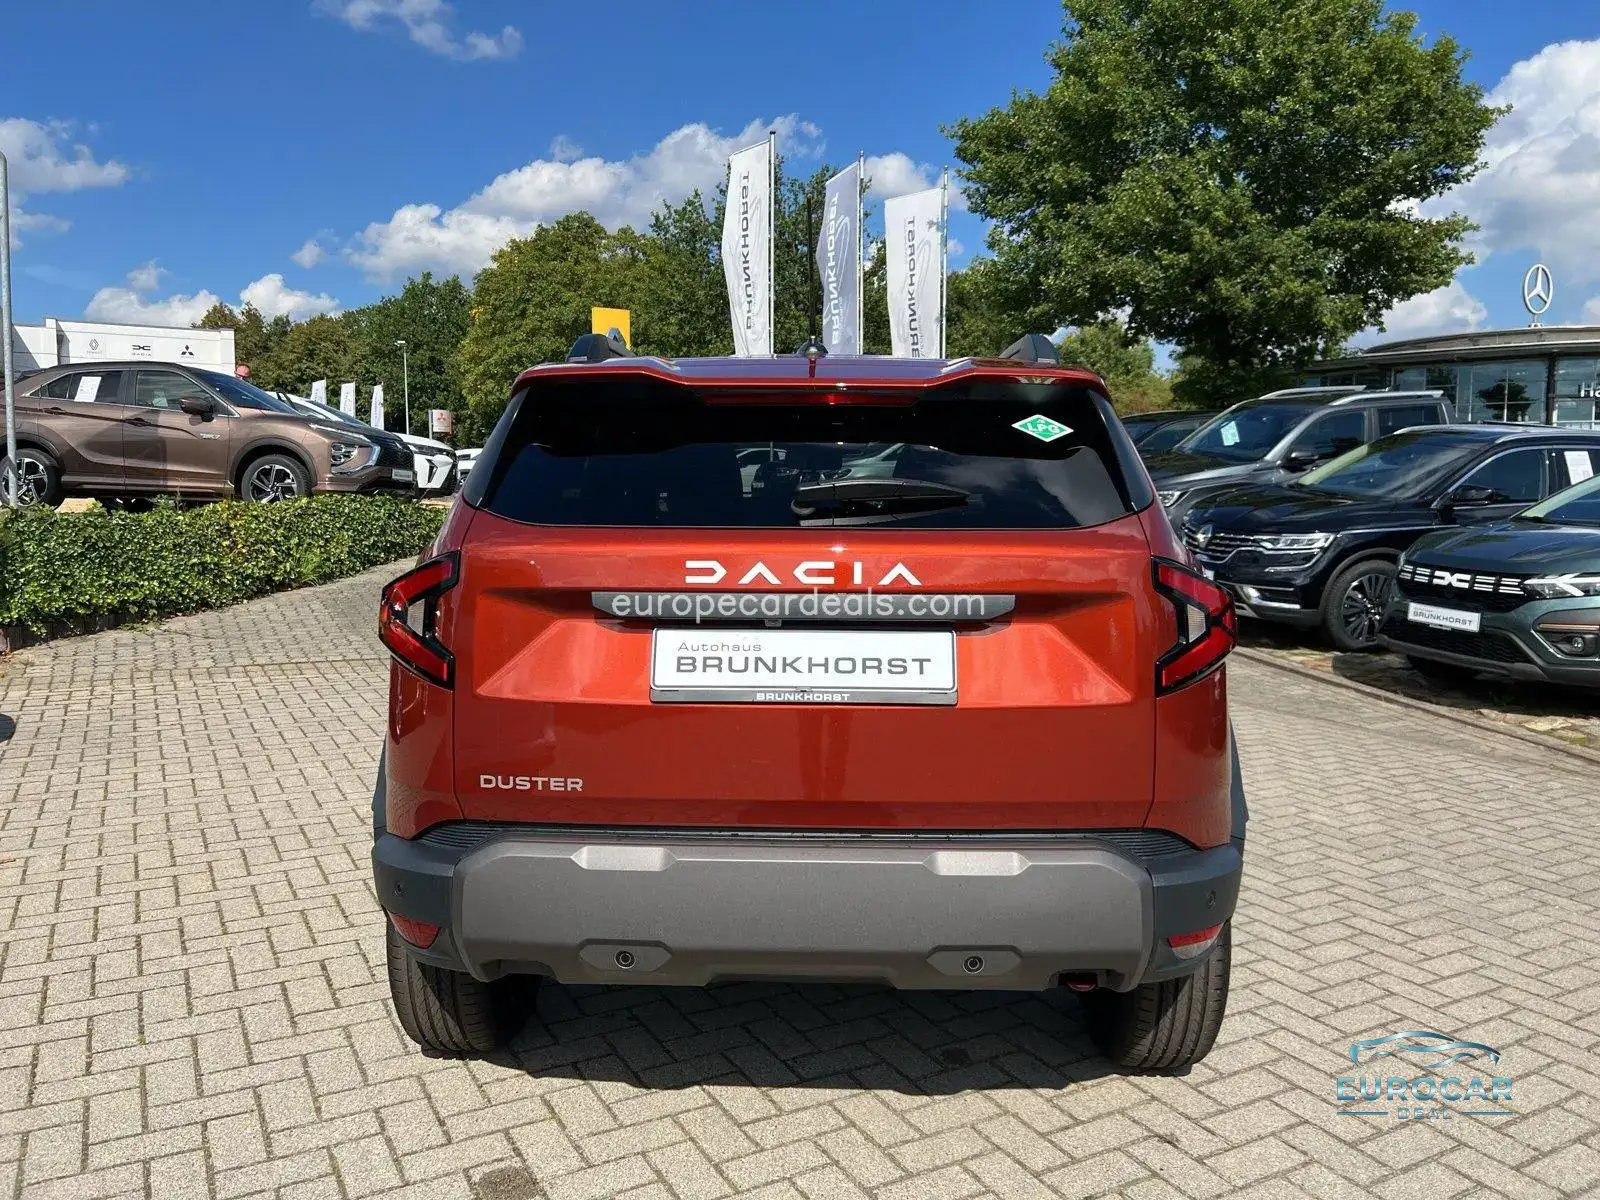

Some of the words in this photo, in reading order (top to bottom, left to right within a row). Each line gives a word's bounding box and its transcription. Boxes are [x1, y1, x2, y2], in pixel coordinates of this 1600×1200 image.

[1026, 422, 1060, 434] LPG
[685, 560, 923, 586] DACIA
[1413, 610, 1473, 627] BRUNKHORST
[677, 642, 762, 652] Autohaus
[675, 655, 931, 675] BRUNKHORST
[756, 692, 850, 701] BRUNKHORST
[479, 774, 583, 792] DUSTER
